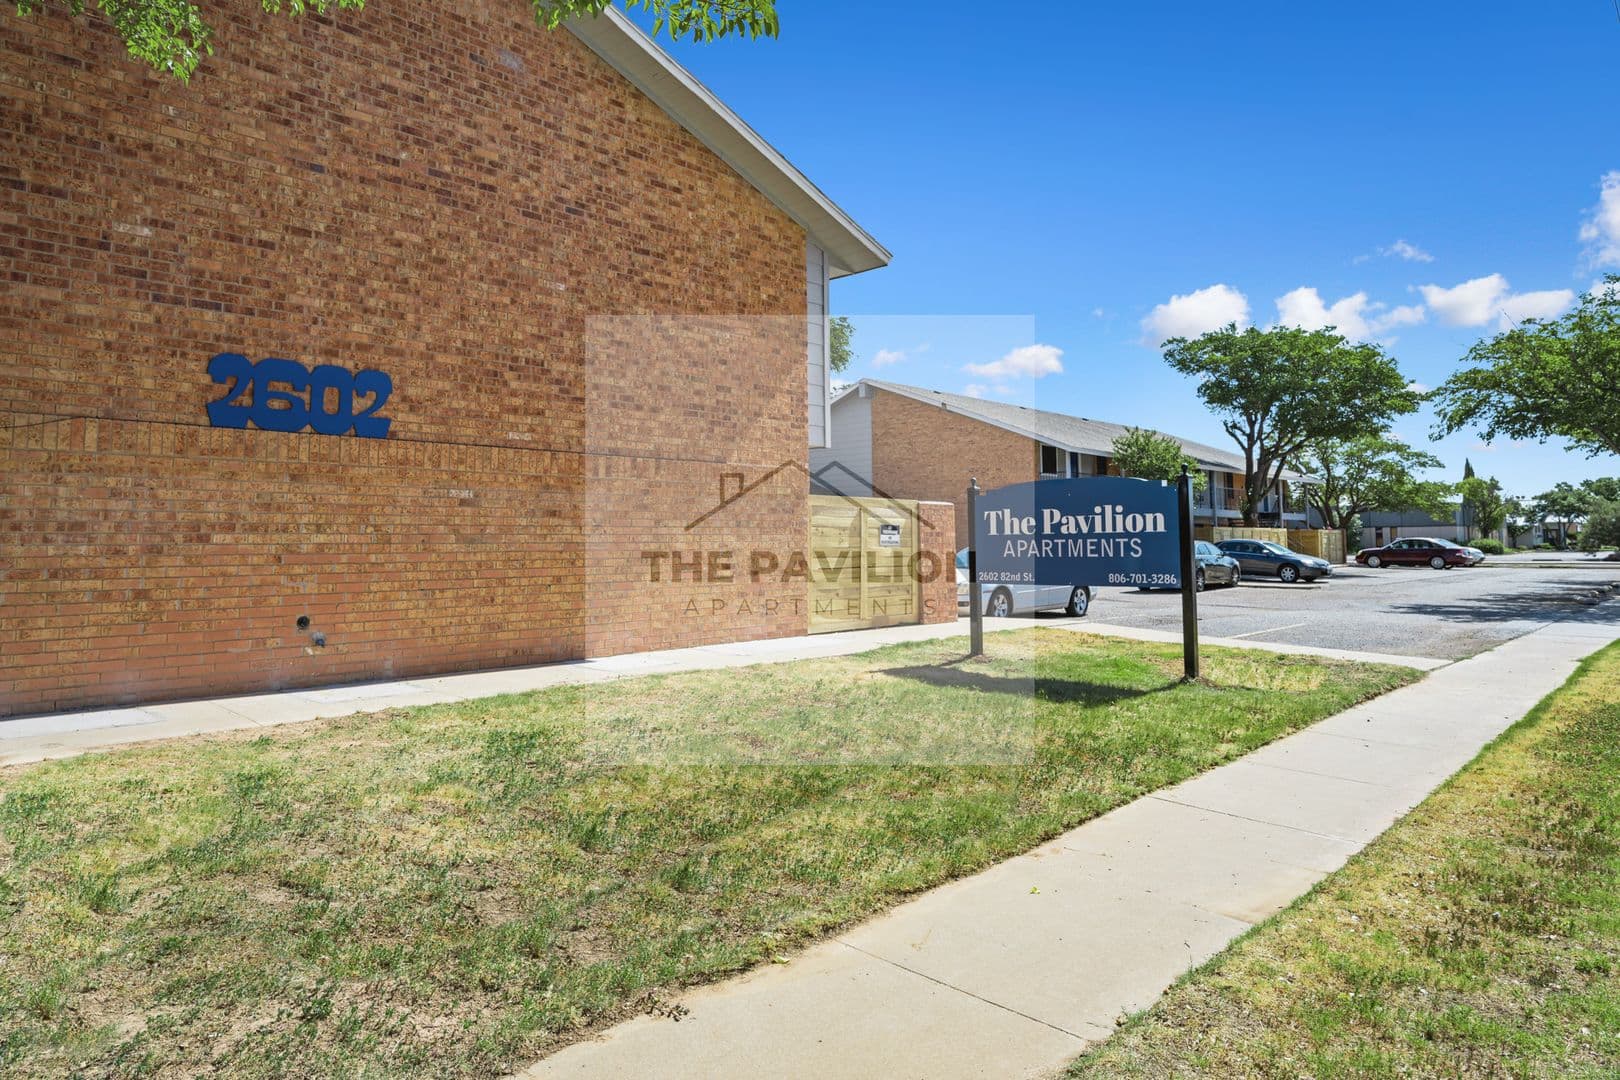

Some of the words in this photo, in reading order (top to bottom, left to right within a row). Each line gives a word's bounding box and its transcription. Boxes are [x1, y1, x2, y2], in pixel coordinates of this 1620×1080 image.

[206, 352, 392, 439] 2602
[984, 508, 1036, 536] The
[1041, 504, 1167, 535] Pavilion
[1003, 538, 1143, 558] APARTMENTS
[978, 572, 999, 581] 2602
[1000, 572, 1021, 581] 82nd
[1023, 572, 1035, 582] St.
[1108, 573, 1177, 585] 806-701-3286
